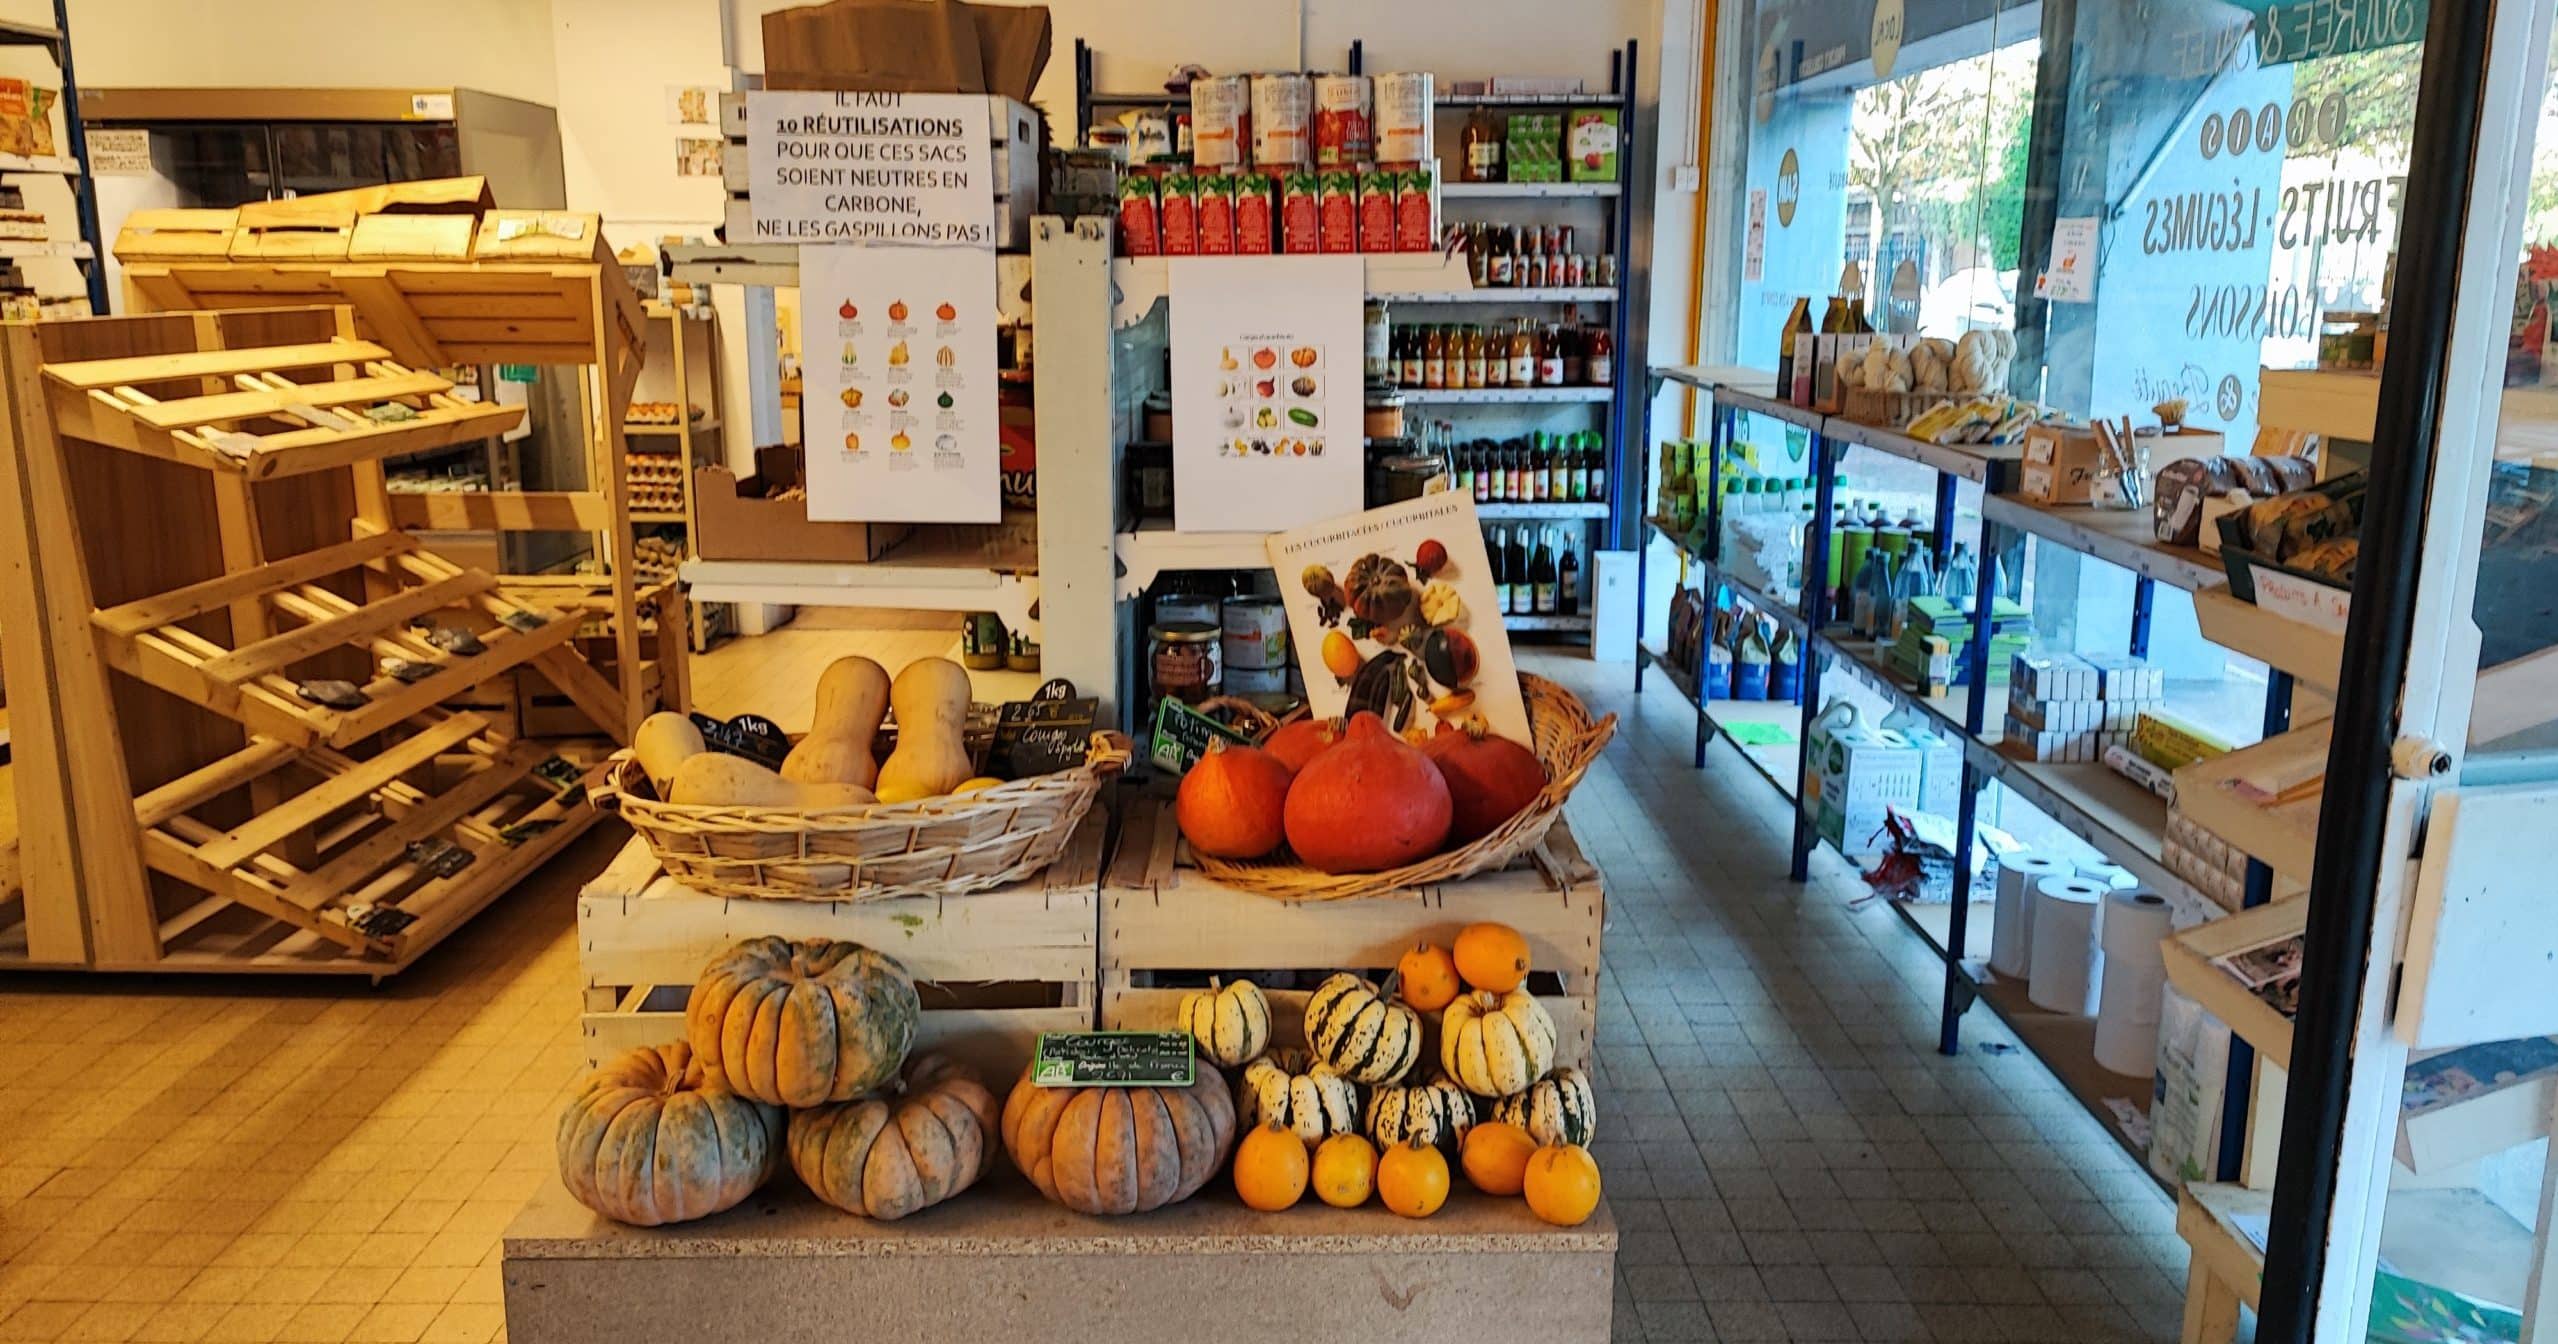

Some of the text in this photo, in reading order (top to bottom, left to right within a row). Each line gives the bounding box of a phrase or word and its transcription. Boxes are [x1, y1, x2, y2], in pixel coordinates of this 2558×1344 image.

[835, 91, 851, 107] IL
[776, 112, 963, 137] 10 RÉUTILISATIONS
[777, 140, 967, 162] POUR QUE CES SACS
[776, 167, 968, 189] SOIENT NEUTRES EN
[825, 194, 921, 217] CARBONE,
[757, 218, 782, 236] NE
[787, 219, 820, 237] LES
[825, 220, 942, 240] GASPILLONS
[946, 223, 980, 242] PAS
[1045, 681, 1067, 700] 1kg
[739, 716, 768, 736] 1kg
